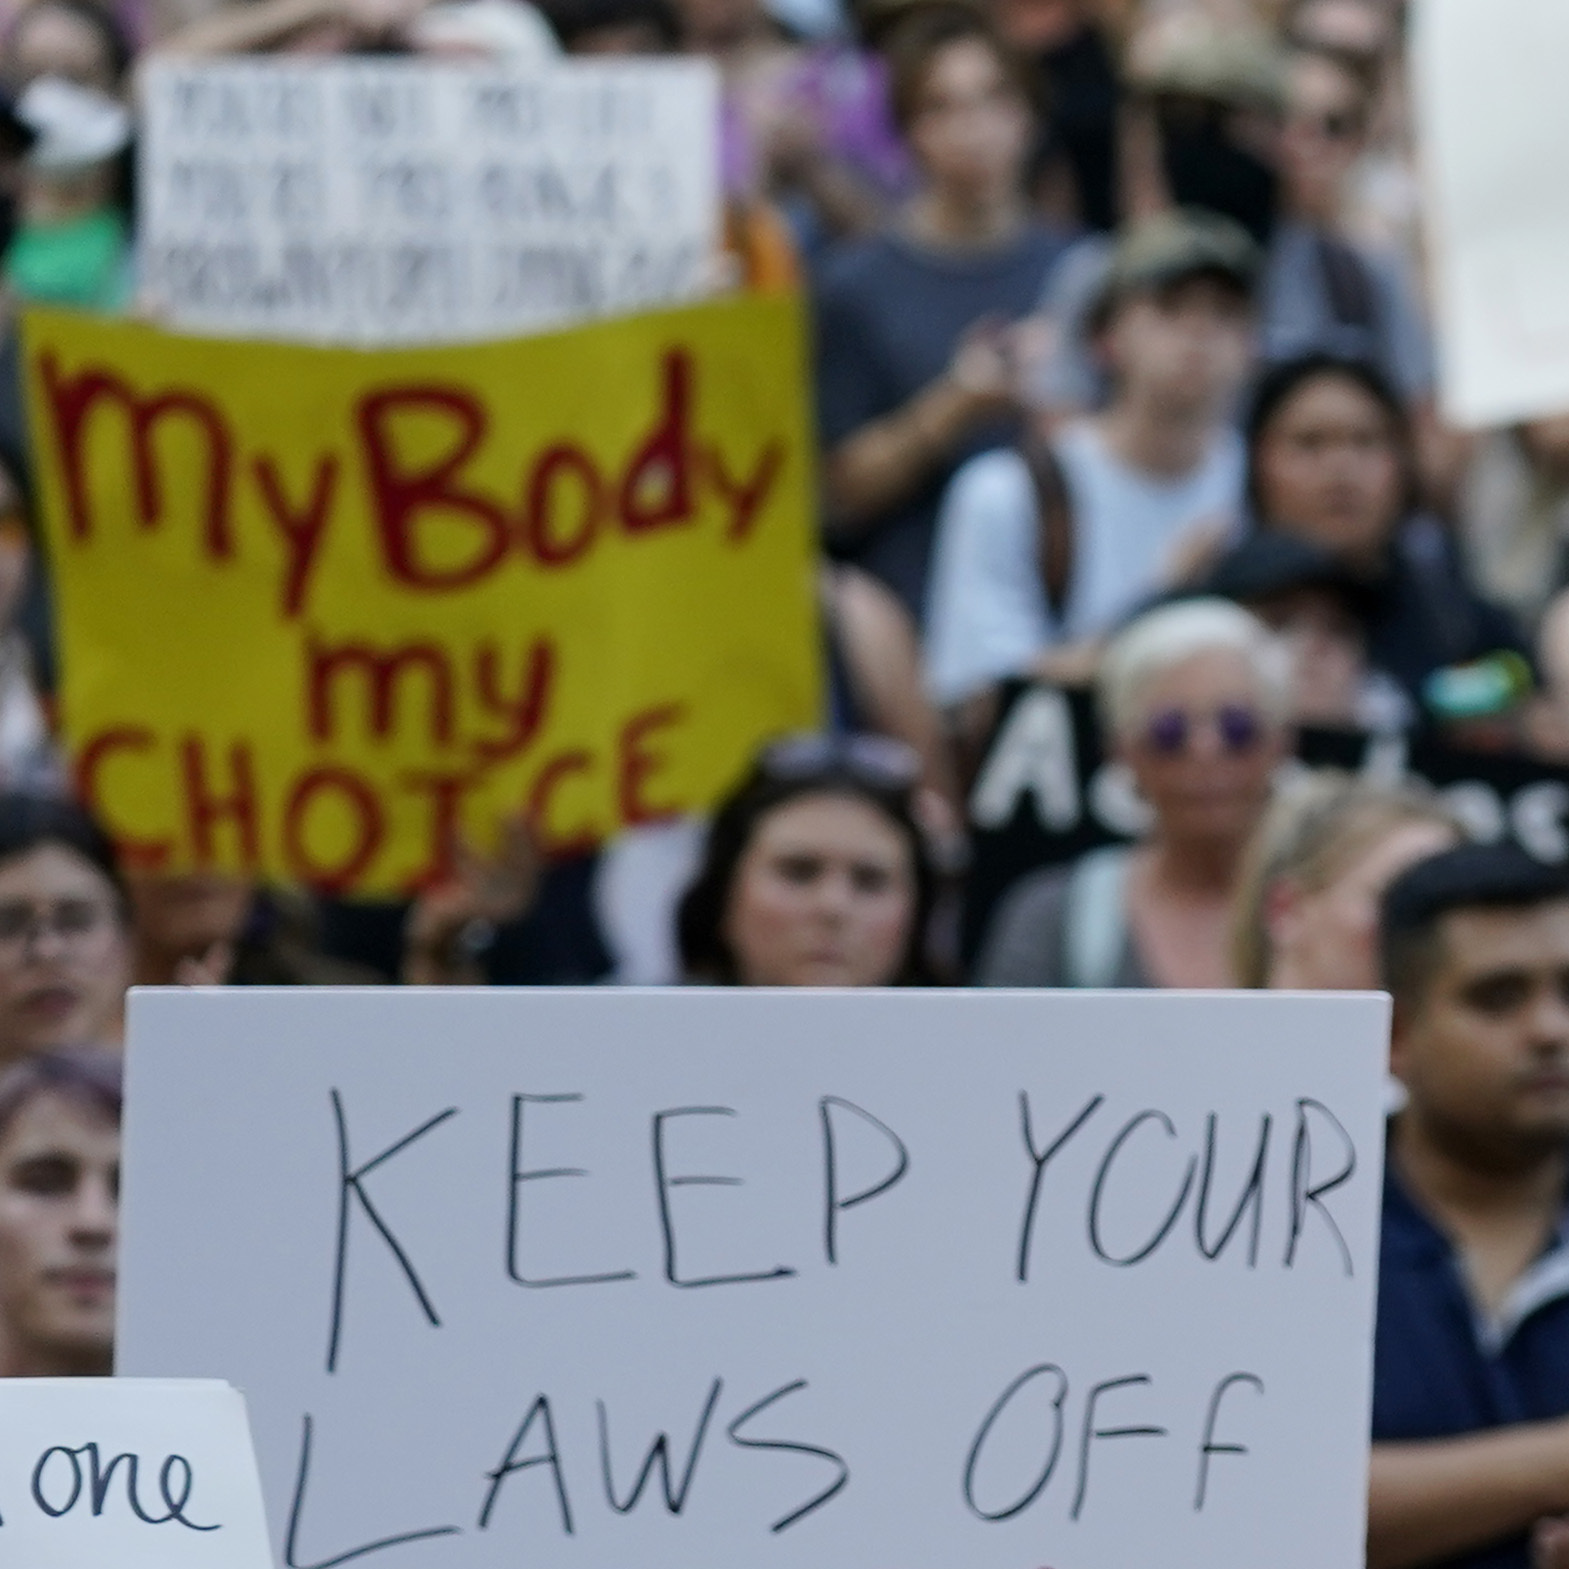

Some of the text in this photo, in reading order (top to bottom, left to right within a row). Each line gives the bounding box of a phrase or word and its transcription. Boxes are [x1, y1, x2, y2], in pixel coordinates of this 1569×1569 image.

[354, 342, 788, 594] Body
[72, 702, 690, 894] CHOICE
[326, 1088, 1358, 1374] KEEP YOUR
[30, 1441, 224, 1531] one
